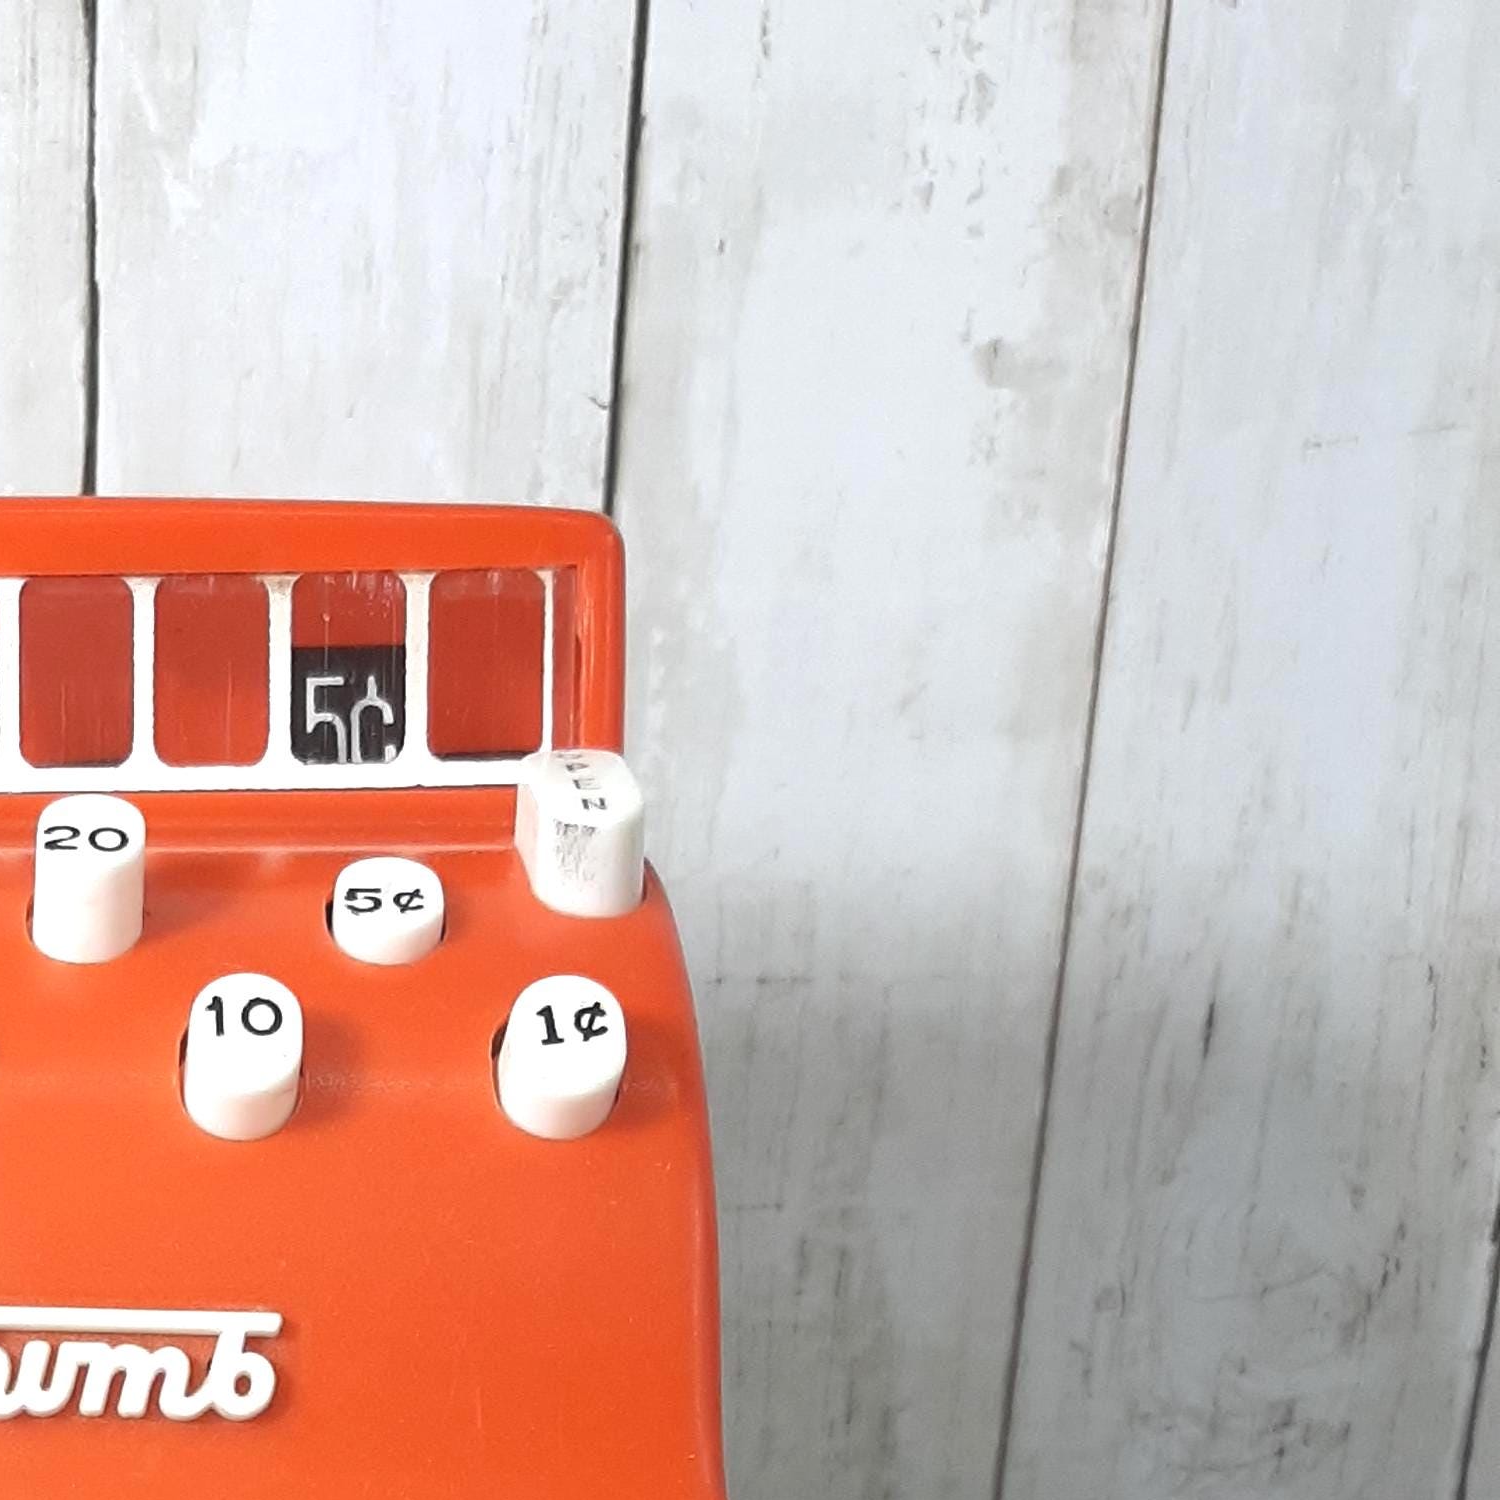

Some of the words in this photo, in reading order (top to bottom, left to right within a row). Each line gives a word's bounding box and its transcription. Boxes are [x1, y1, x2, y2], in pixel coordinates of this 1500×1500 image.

[43, 825, 130, 852] 20
[344, 887, 424, 916] 5¢
[206, 995, 283, 1037] 10
[536, 1001, 609, 1046] 1¢
